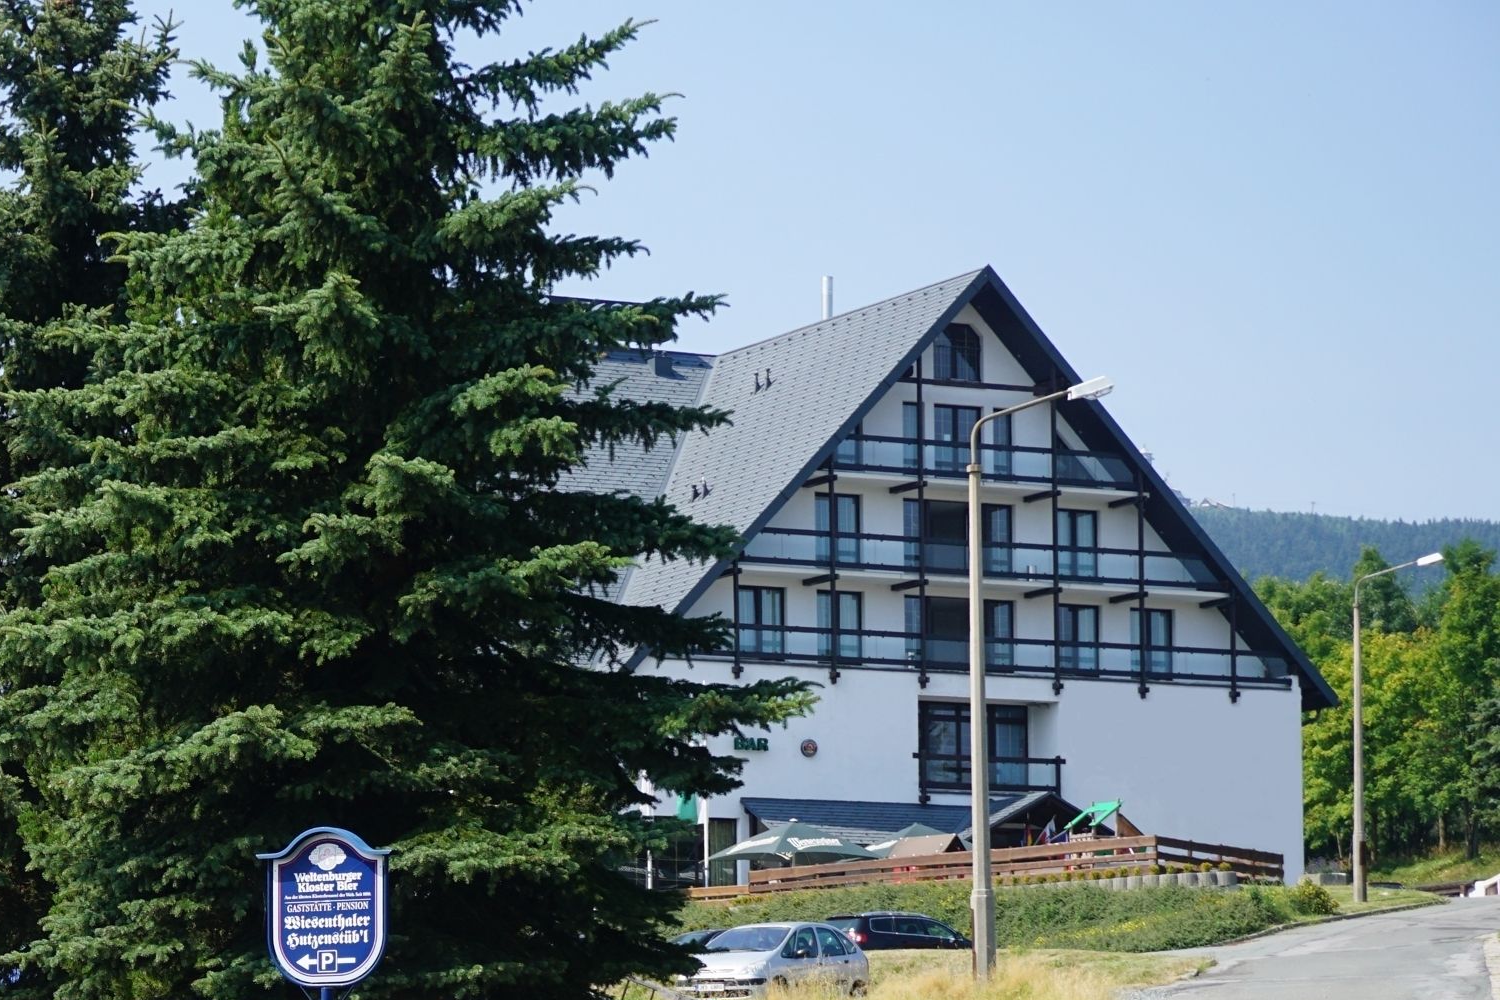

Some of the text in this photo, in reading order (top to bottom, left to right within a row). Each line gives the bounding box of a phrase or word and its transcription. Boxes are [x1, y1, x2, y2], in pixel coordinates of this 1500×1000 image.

[734, 737, 769, 751] BAR
[293, 871, 362, 883] Weltenburger
[298, 881, 359, 893] Kloster Bier
[287, 901, 332, 913] GASTSTÄTTE
[337, 901, 369, 911] PENSION
[284, 913, 371, 930] Wiesenthaler
[286, 929, 368, 949] Hutzenstüb'l
[321, 953, 334, 971] P
